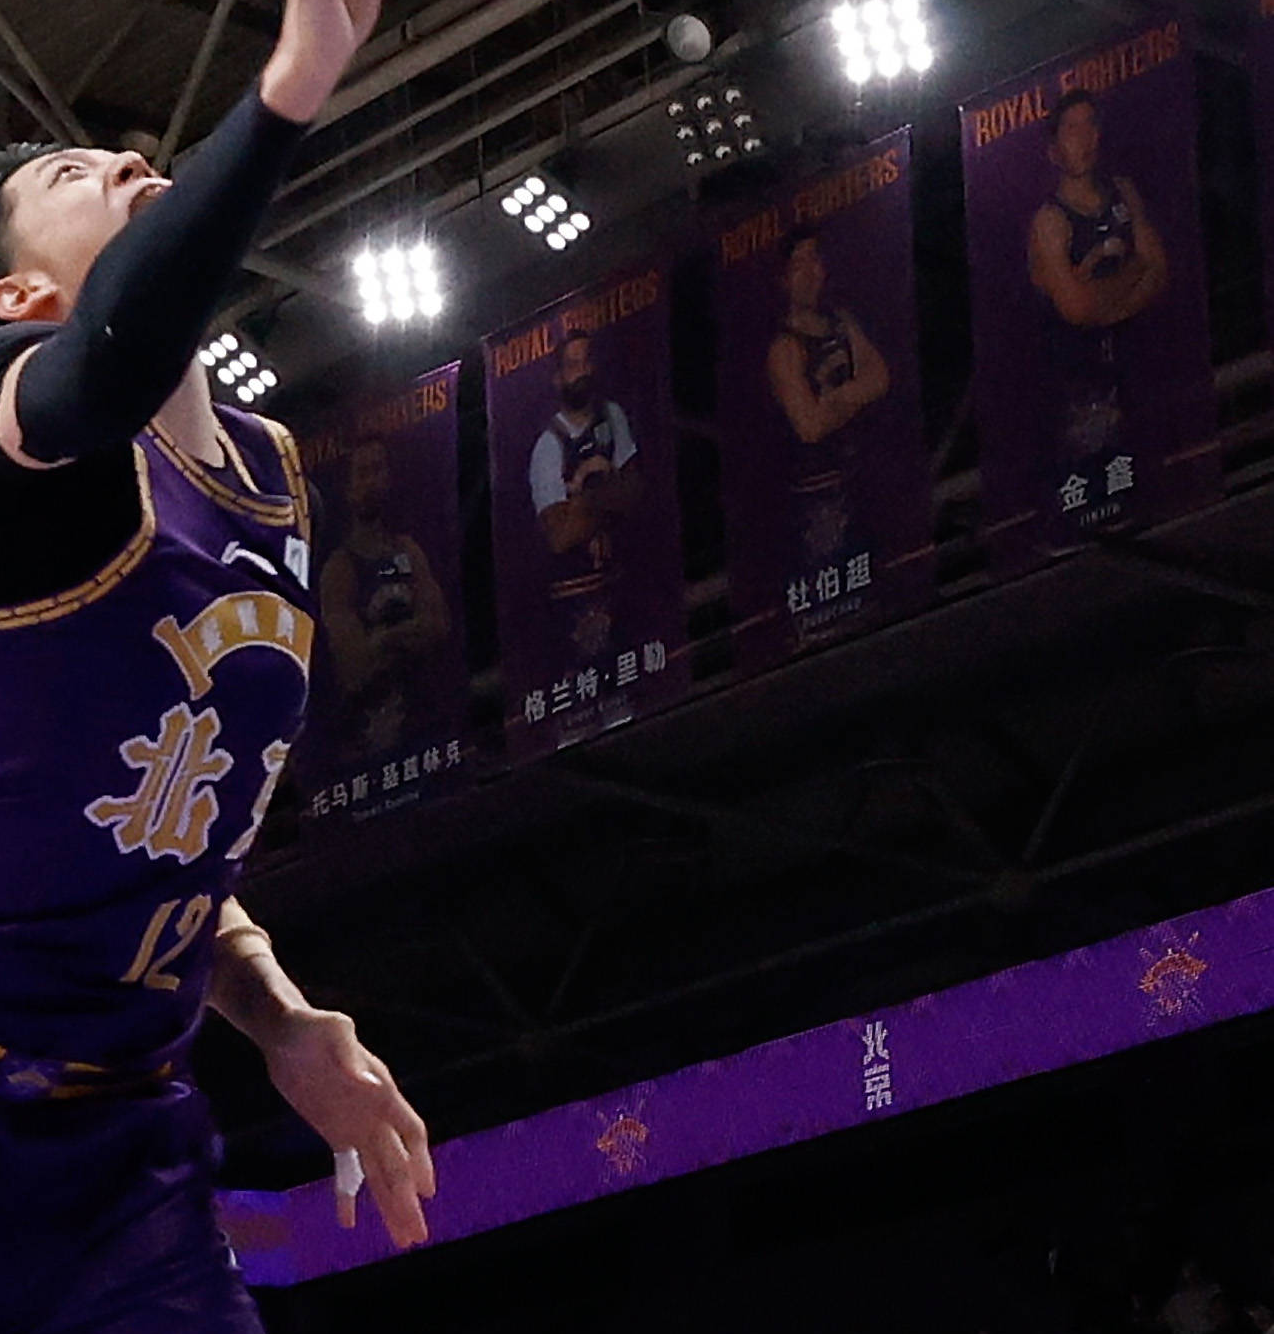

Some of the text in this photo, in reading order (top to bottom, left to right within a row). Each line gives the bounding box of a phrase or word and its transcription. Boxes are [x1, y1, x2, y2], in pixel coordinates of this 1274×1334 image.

[973, 86, 1050, 148] ROYAL
[1059, 453, 1135, 513] 金鑫
[786, 551, 873, 615] 杜伯超
[119, 893, 213, 993] 12
[862, 1020, 893, 1110] 北京
